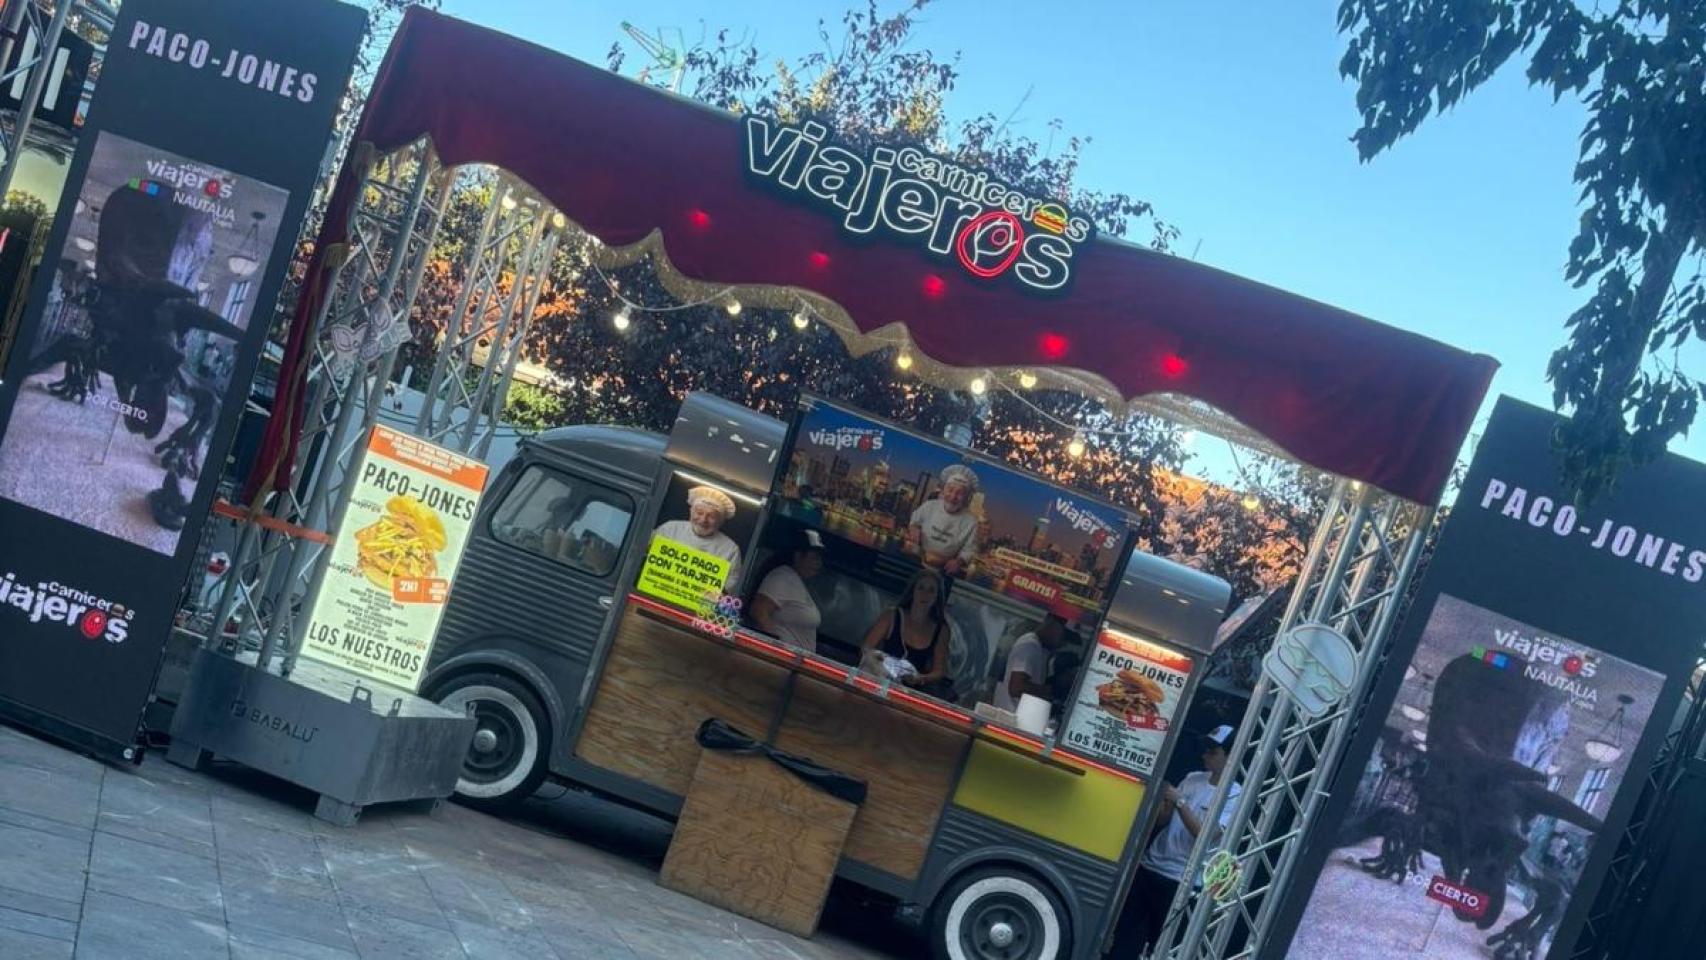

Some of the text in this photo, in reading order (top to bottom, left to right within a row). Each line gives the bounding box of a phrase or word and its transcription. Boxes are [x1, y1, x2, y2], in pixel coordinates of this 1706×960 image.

[128, 20, 318, 103] PACO-JONES
[146, 159, 234, 199] viajeros
[748, 118, 1073, 289] viajeros
[809, 428, 884, 453] viajeros
[362, 463, 476, 521] PACO-JONES
[1481, 478, 1706, 583] PACO-JONES
[647, 554, 672, 571] CON
[675, 563, 722, 588] TARJETA
[659, 545, 720, 574] SOLO PAGO
[0, 572, 129, 643] iajeros
[309, 621, 341, 646] LOS
[342, 631, 422, 672] NUESTROS
[1494, 629, 1598, 677] viajeros
[1098, 650, 1185, 688] PACO-JONES
[1523, 665, 1598, 702] NAUTALIA
[1068, 730, 1090, 746] LOS
[1092, 738, 1154, 767] NUESTROS
